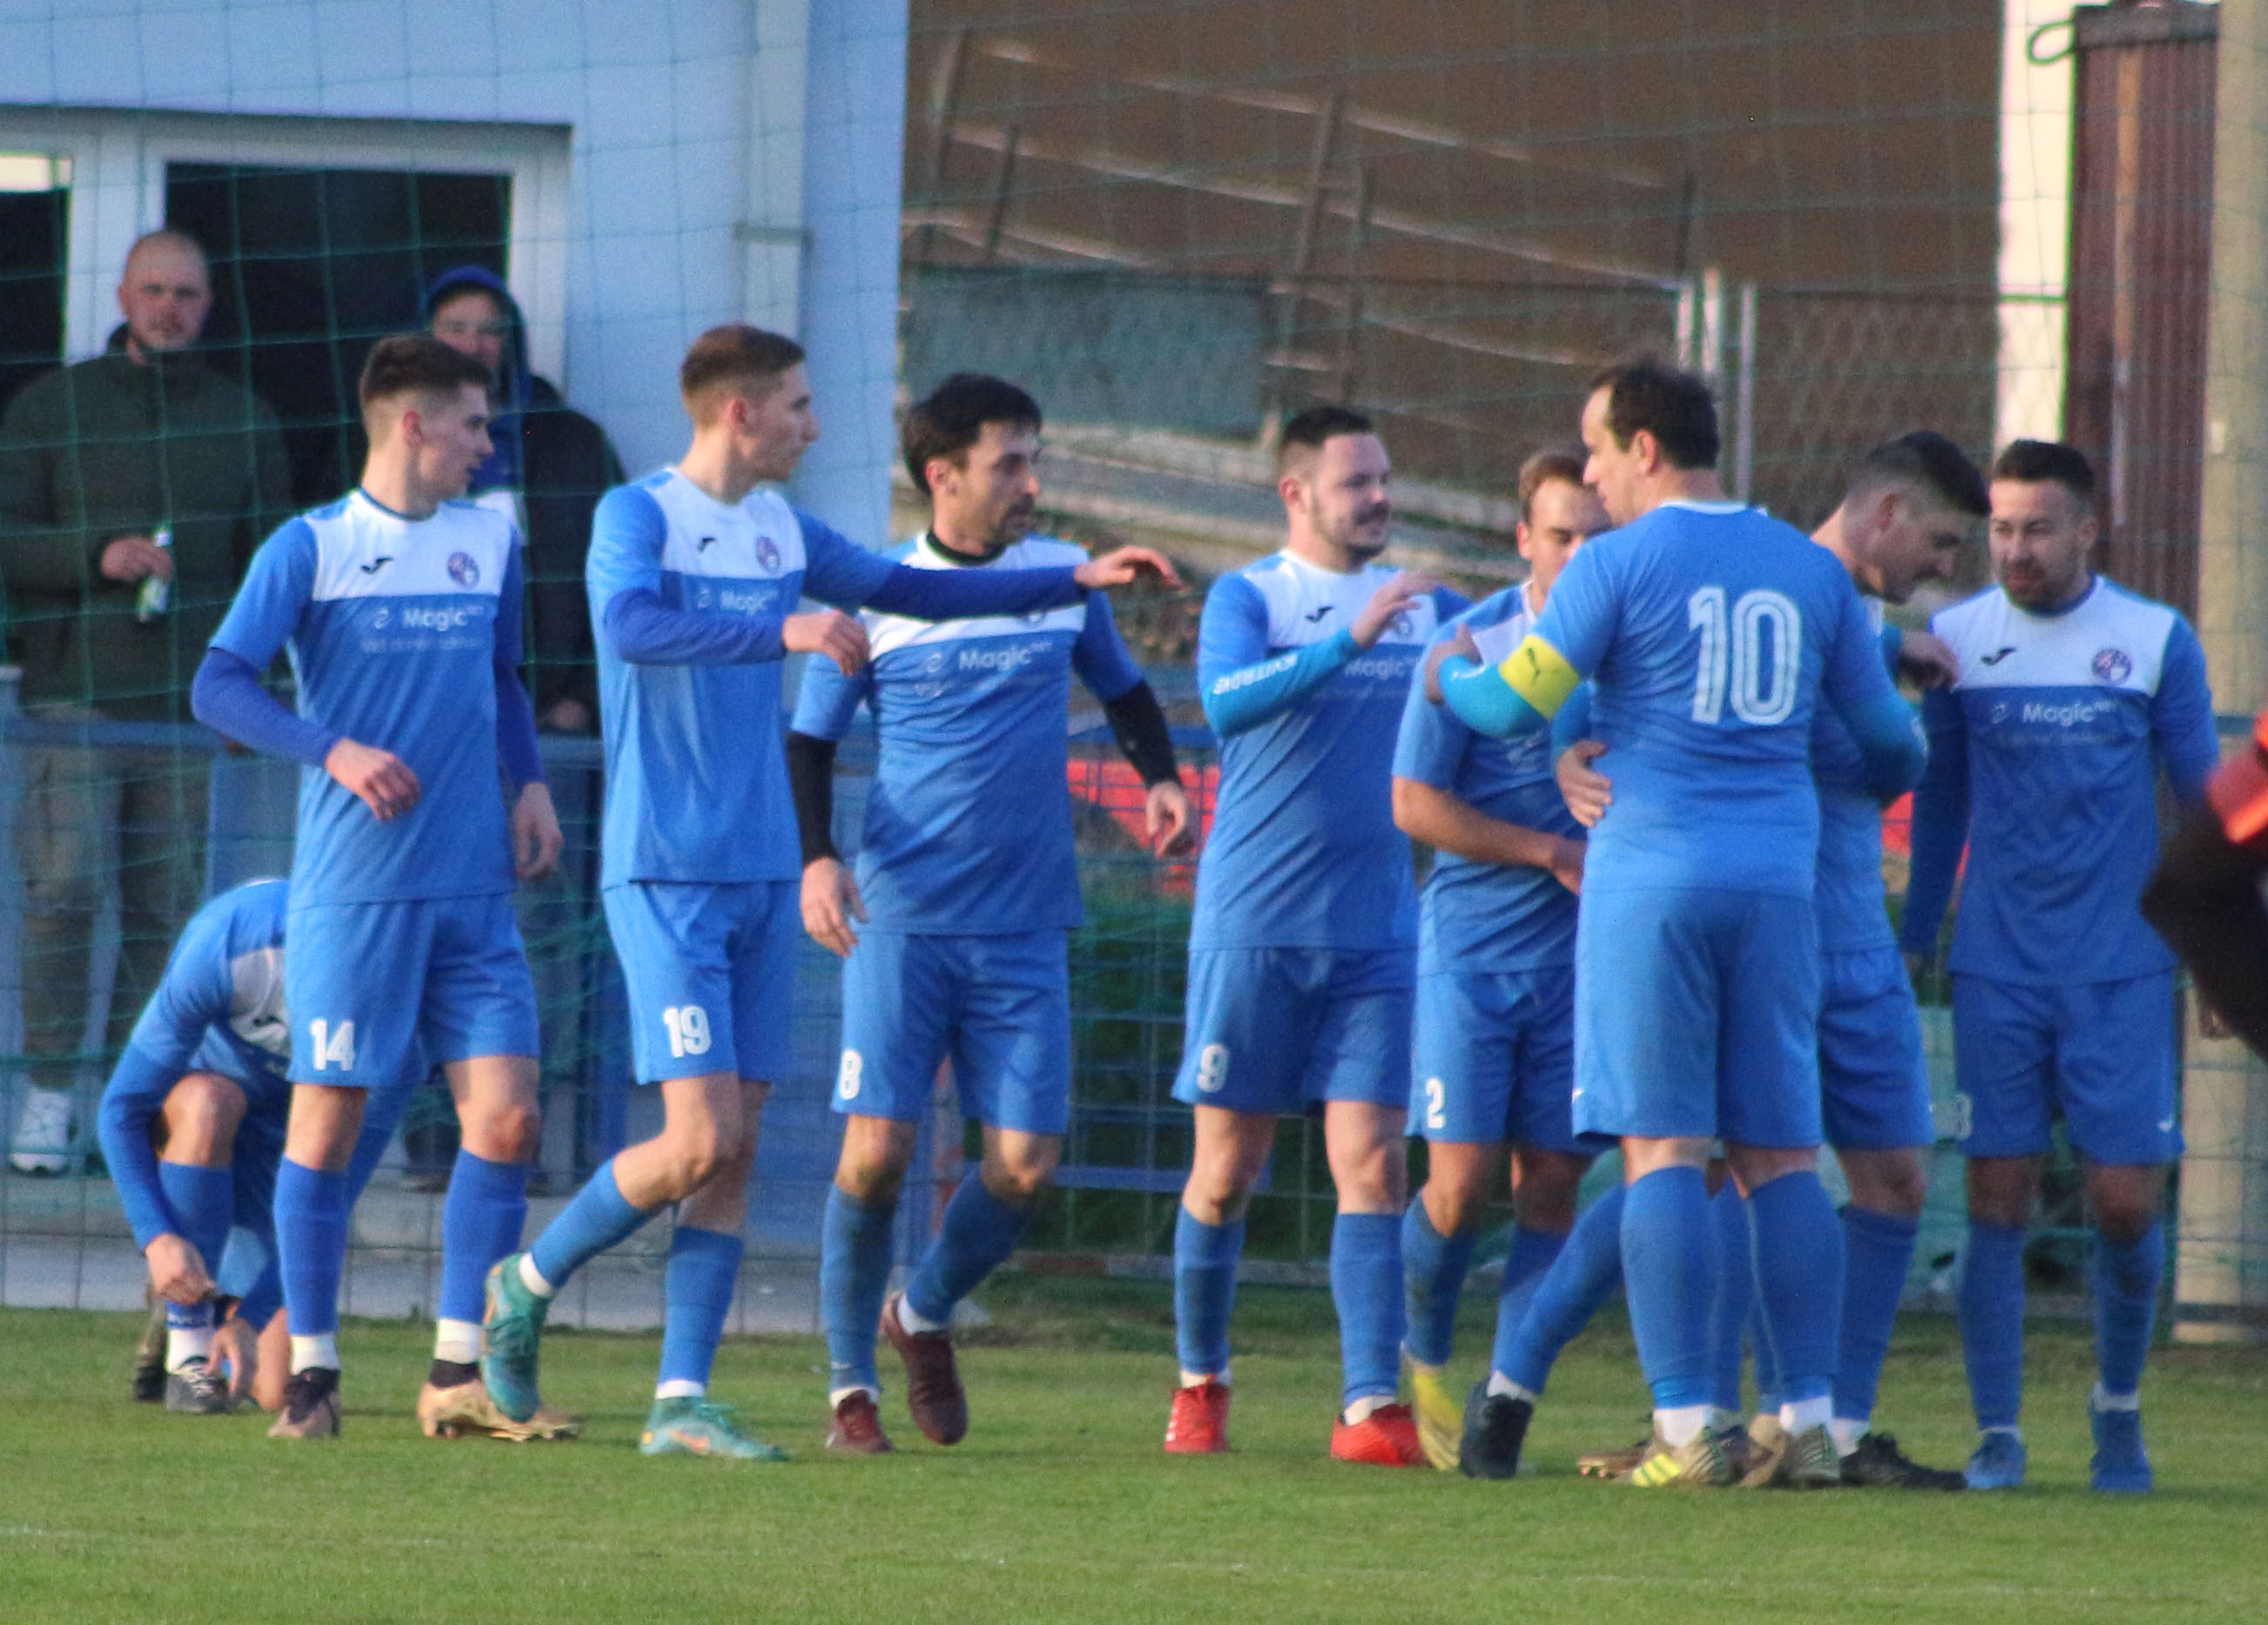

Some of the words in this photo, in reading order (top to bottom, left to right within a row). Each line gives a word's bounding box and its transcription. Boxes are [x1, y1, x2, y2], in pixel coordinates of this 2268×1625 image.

[402, 607, 468, 632] Magic
[959, 645, 1033, 672] Magic
[1688, 586, 1802, 725] 10
[2022, 699, 2096, 728] Magic
[310, 1018, 355, 1072] 14
[664, 1004, 712, 1058] 19
[840, 1048, 862, 1100] 8
[1197, 1043, 1229, 1094] 9
[1426, 1077, 1445, 1129] 2
